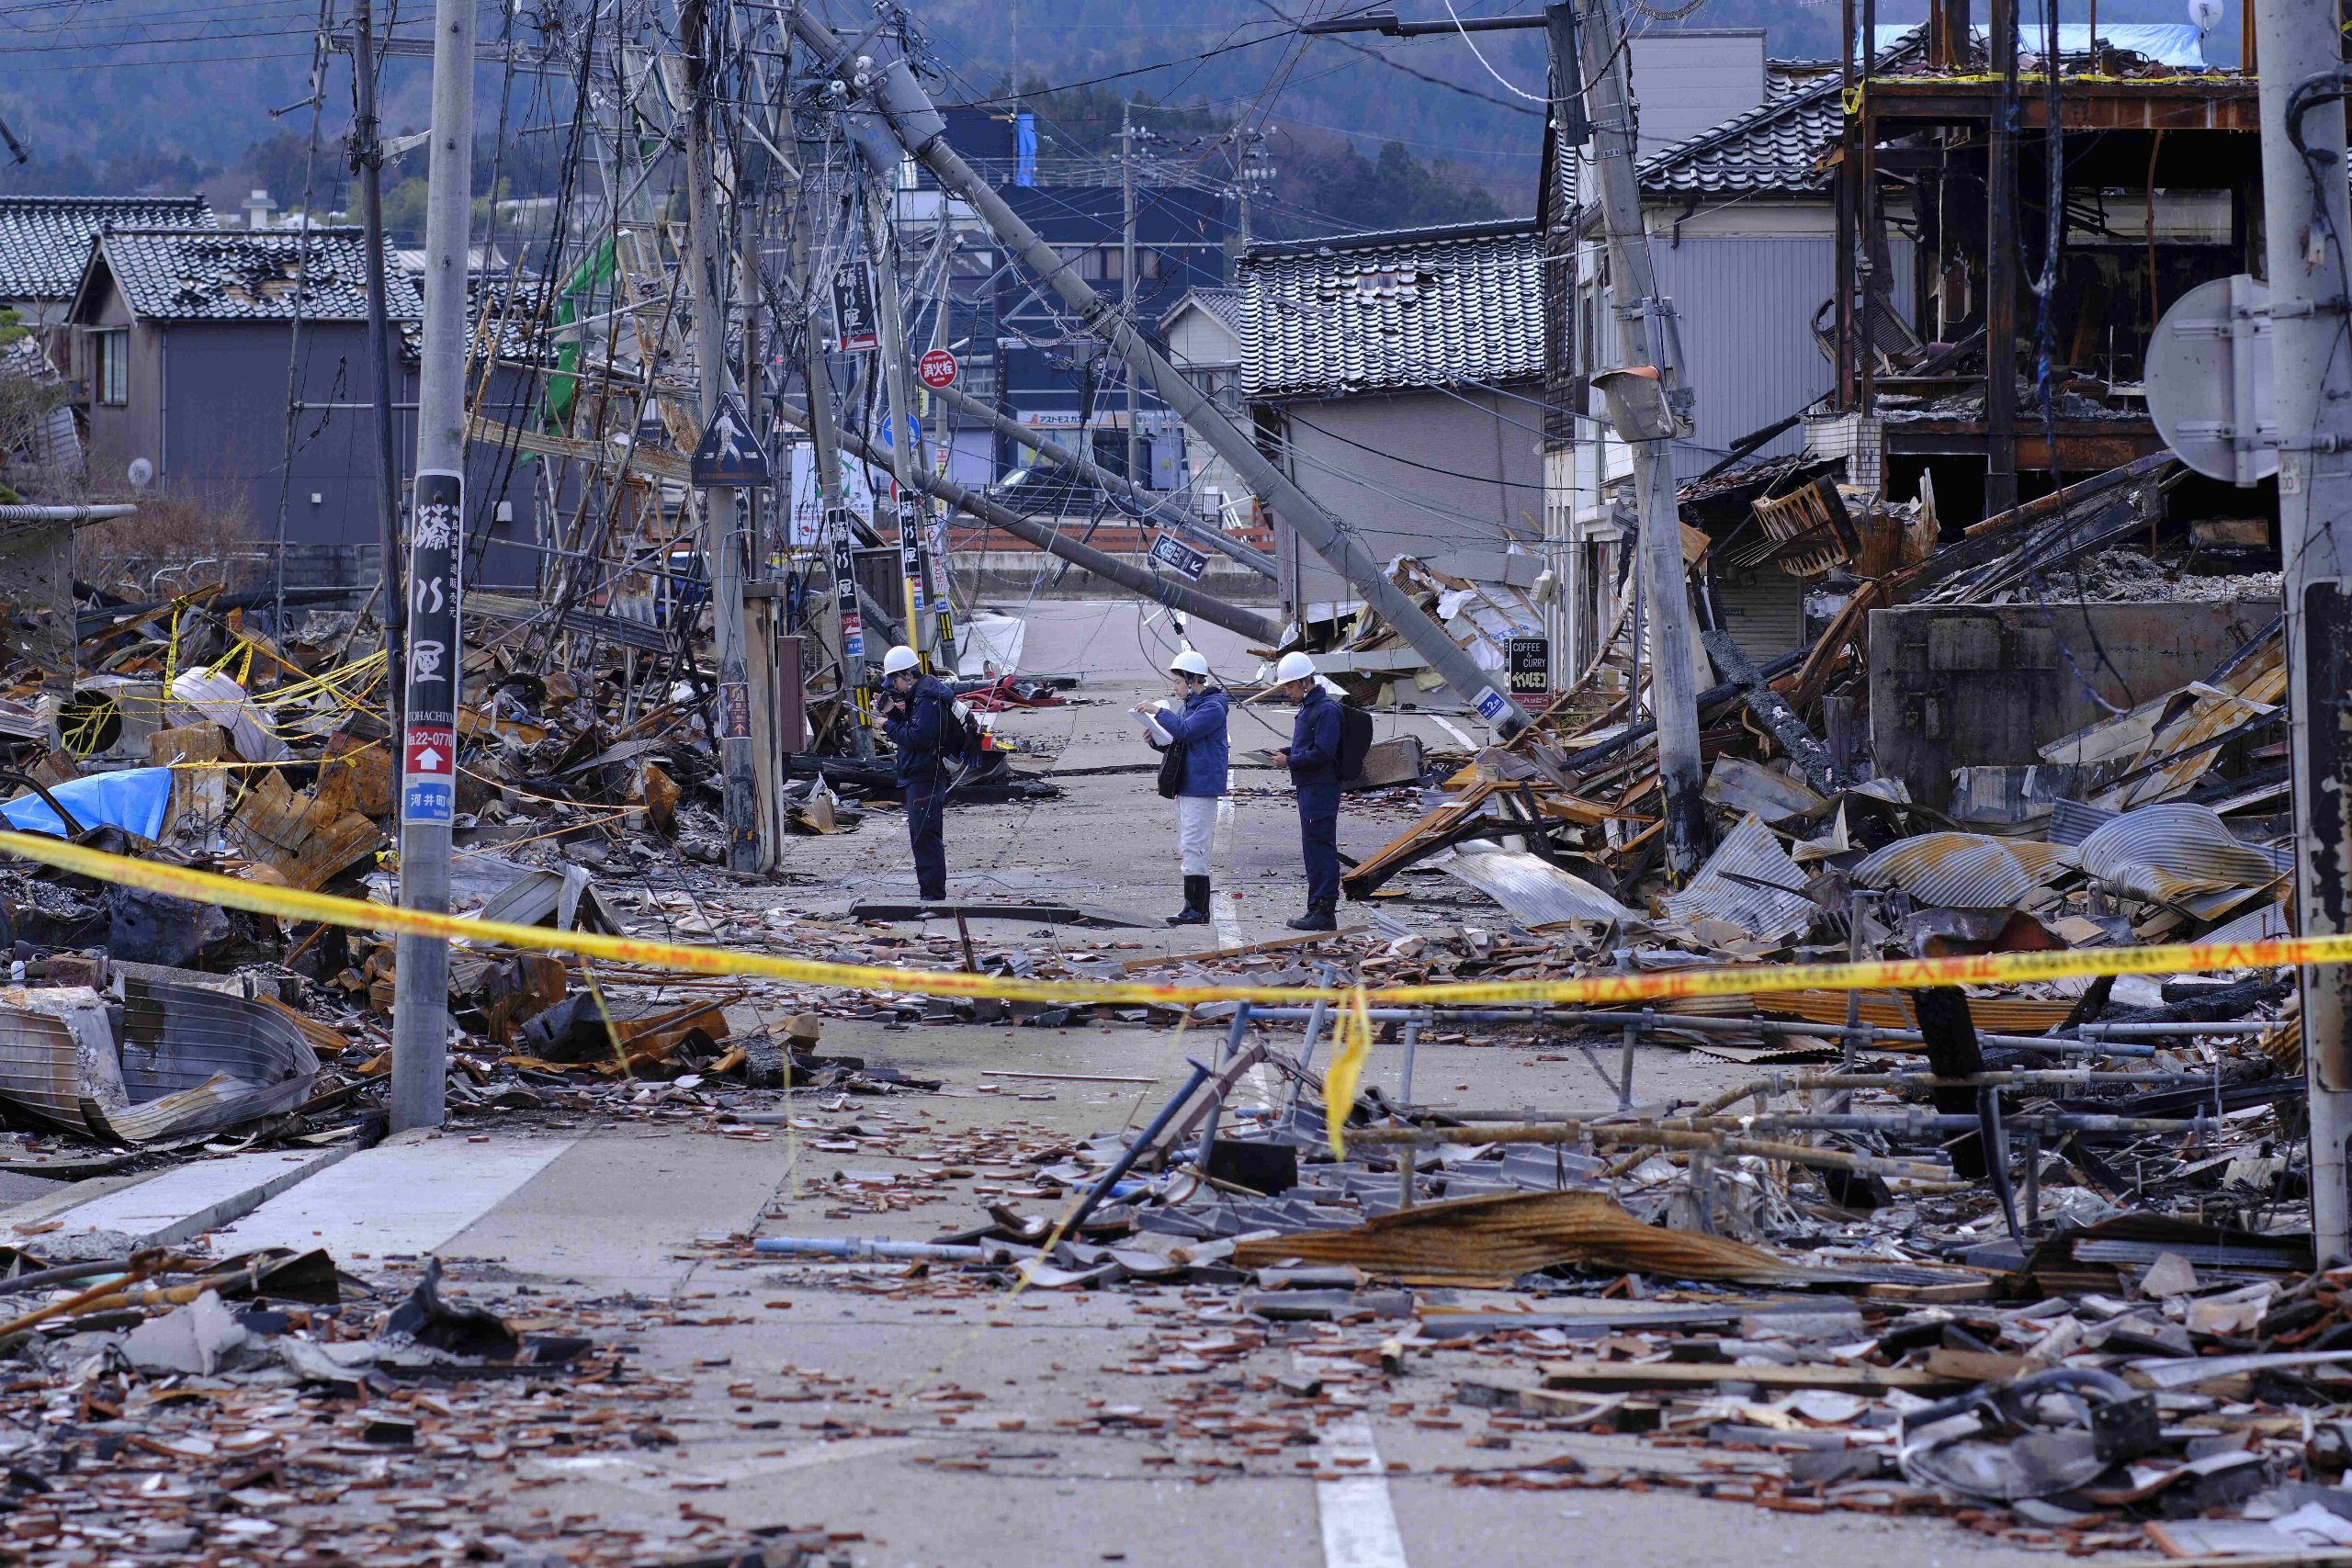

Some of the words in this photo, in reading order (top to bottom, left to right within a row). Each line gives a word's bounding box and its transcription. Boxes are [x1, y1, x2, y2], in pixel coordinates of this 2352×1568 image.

[922, 360, 954, 378] 消火栓
[410, 503, 451, 685] 藤八屋
[1512, 642, 1541, 652] COFFEE
[1522, 658, 1546, 668] CURRY
[1511, 671, 1547, 688] ペペルモコ
[408, 710, 454, 723] TOHACHIYA
[411, 794, 447, 807] 河井町
[2188, 942, 2315, 970] 立入禁止
